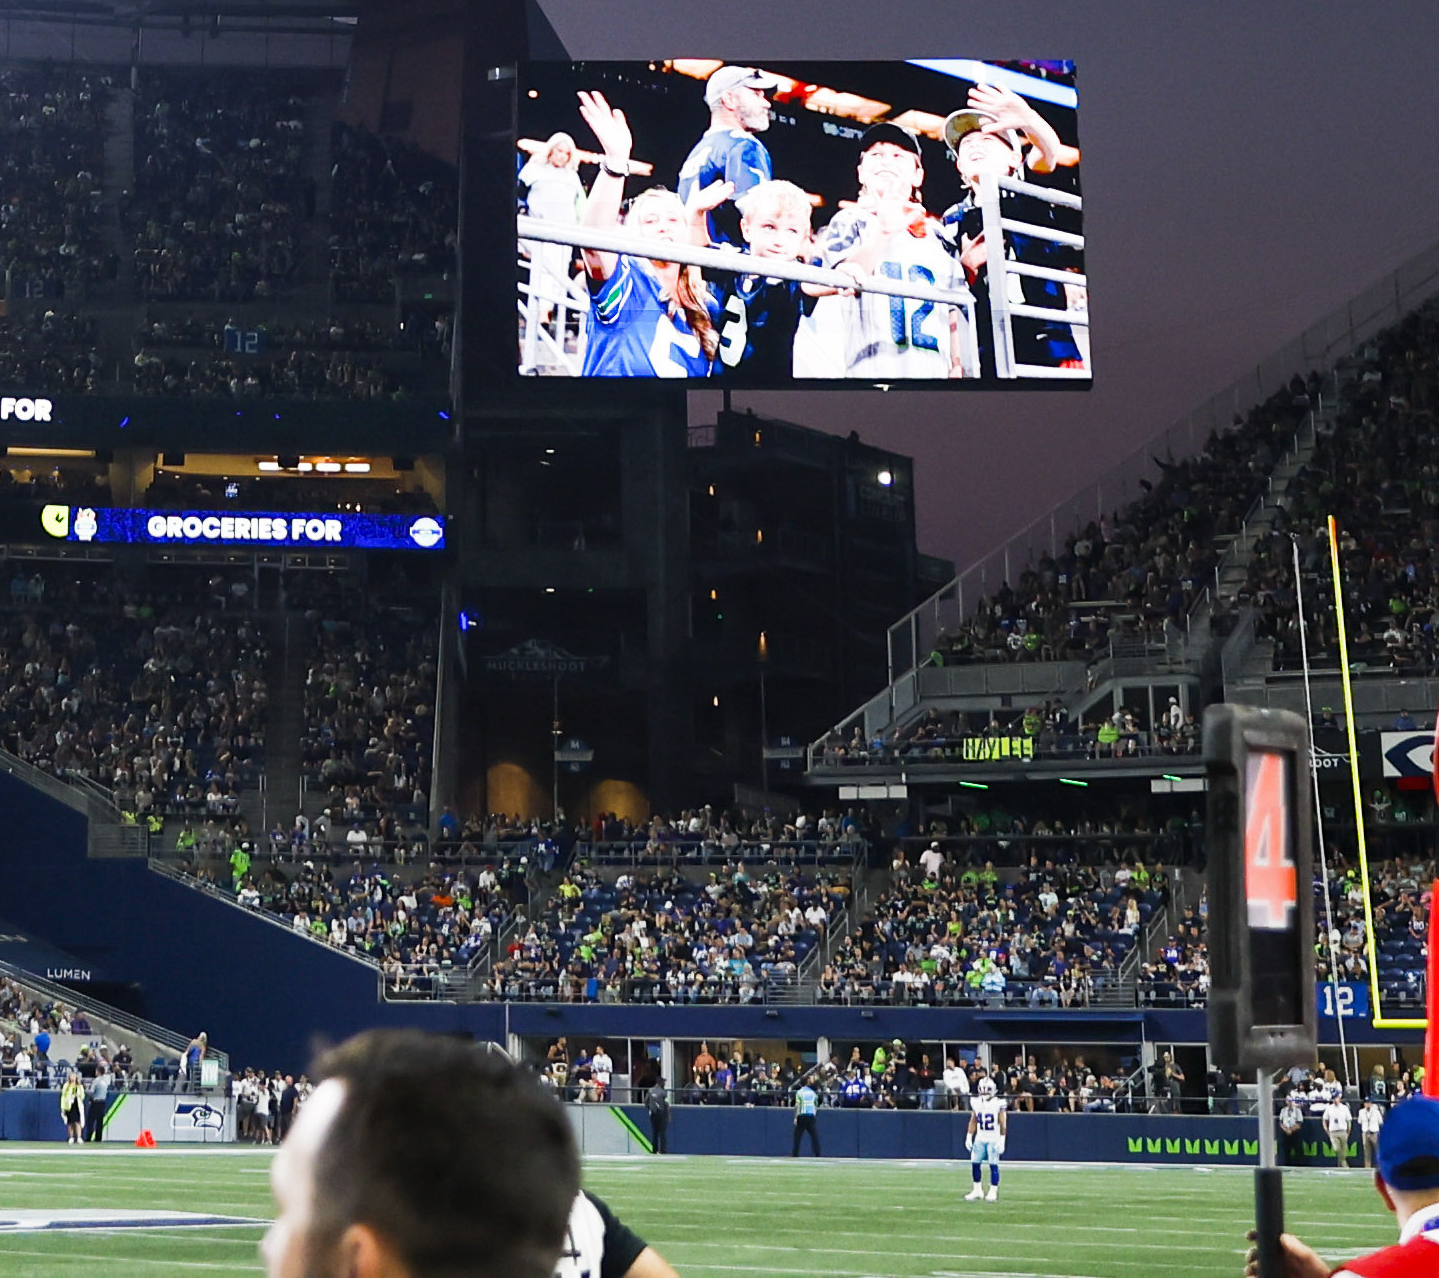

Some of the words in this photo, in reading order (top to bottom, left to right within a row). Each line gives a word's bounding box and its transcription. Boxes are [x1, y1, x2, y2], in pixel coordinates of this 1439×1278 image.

[880, 261, 940, 352] 12
[234, 331, 259, 354] 12
[1, 398, 53, 422] FOR
[148, 516, 288, 541] GROCERIES
[291, 518, 343, 542] FOR
[1245, 752, 1298, 929] 4
[47, 967, 91, 981] LUMEN
[1323, 985, 1354, 1017] 12
[976, 1113, 995, 1130] 42
